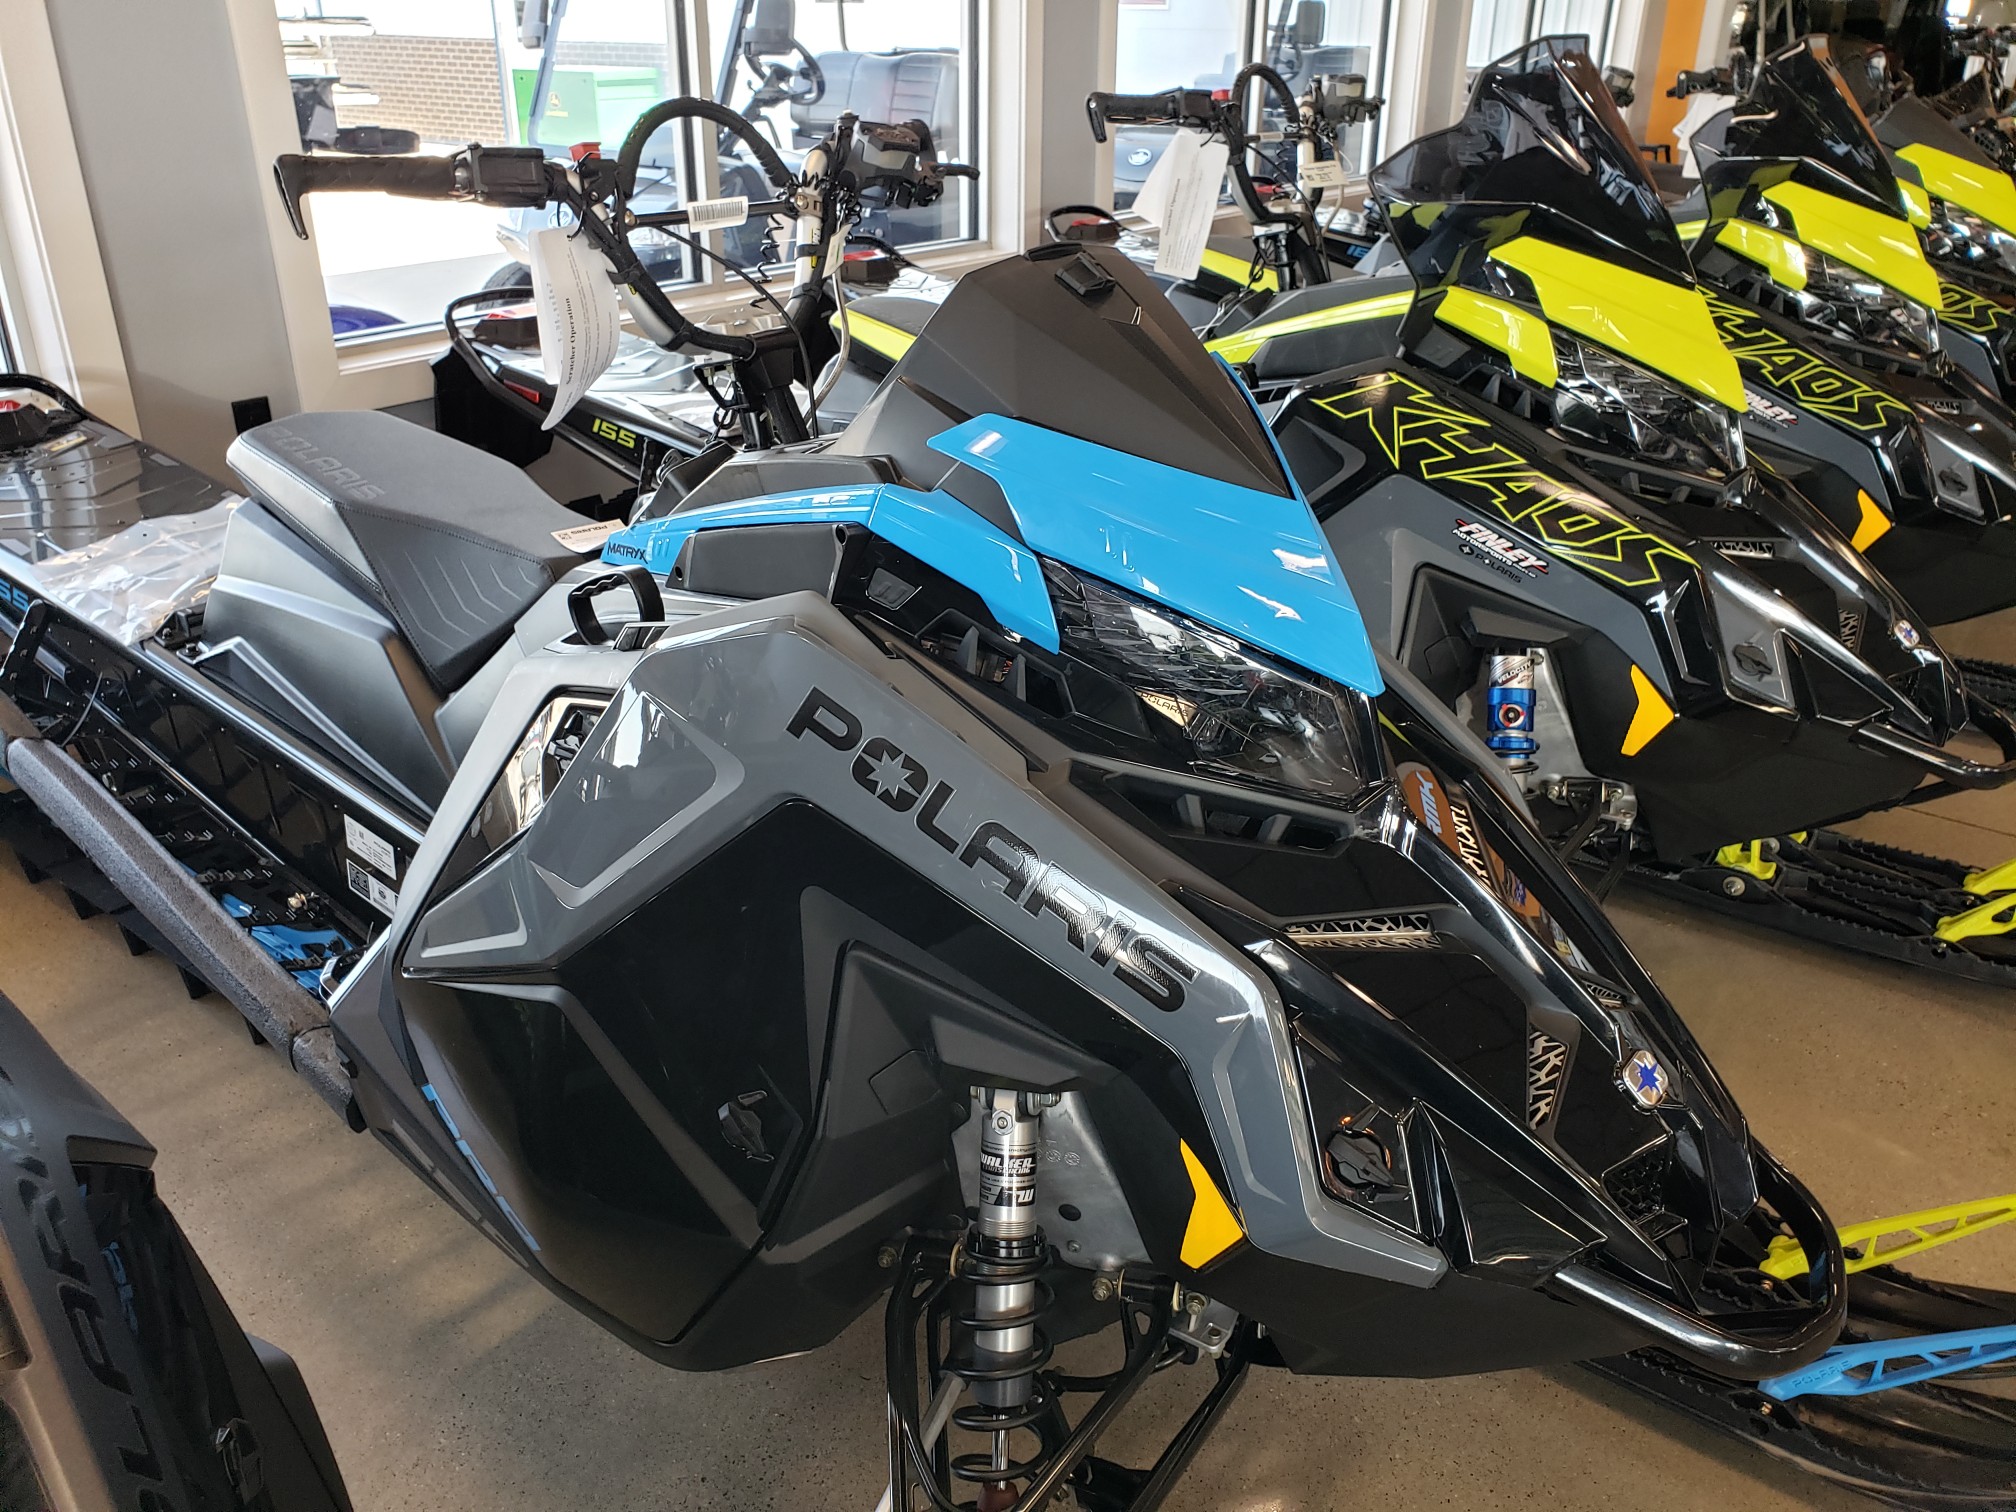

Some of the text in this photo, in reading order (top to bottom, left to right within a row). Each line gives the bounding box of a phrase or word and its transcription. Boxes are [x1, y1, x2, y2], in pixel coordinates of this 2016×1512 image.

[565, 297, 577, 386] Scratcher Operation
[592, 418, 636, 449] 155
[262, 425, 386, 500] POLARIS
[1311, 371, 1701, 587] KHAOS
[607, 541, 649, 564] MATRYX
[1452, 528, 1513, 567] MOTORSPORTS
[1458, 521, 1549, 569] FINLEY
[1475, 553, 1523, 583] POLARIS
[1140, 691, 1189, 717] POLARIS
[785, 684, 1201, 1013] POLARIS
[1791, 1360, 1853, 1389] POLARIS
